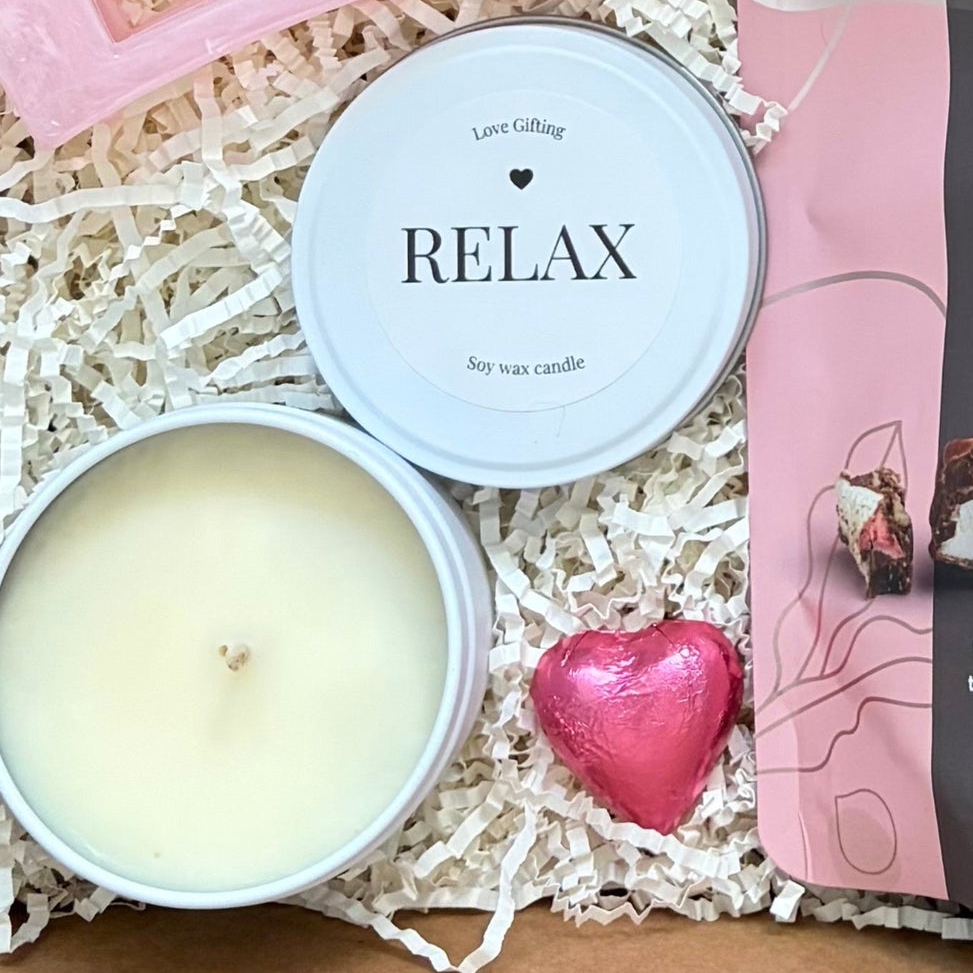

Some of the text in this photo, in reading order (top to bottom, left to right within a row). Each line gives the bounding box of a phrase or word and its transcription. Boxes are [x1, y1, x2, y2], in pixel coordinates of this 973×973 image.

[472, 118, 566, 140] Love Gifting
[402, 224, 636, 283] RELAX
[466, 356, 584, 376] Soy wax candle
